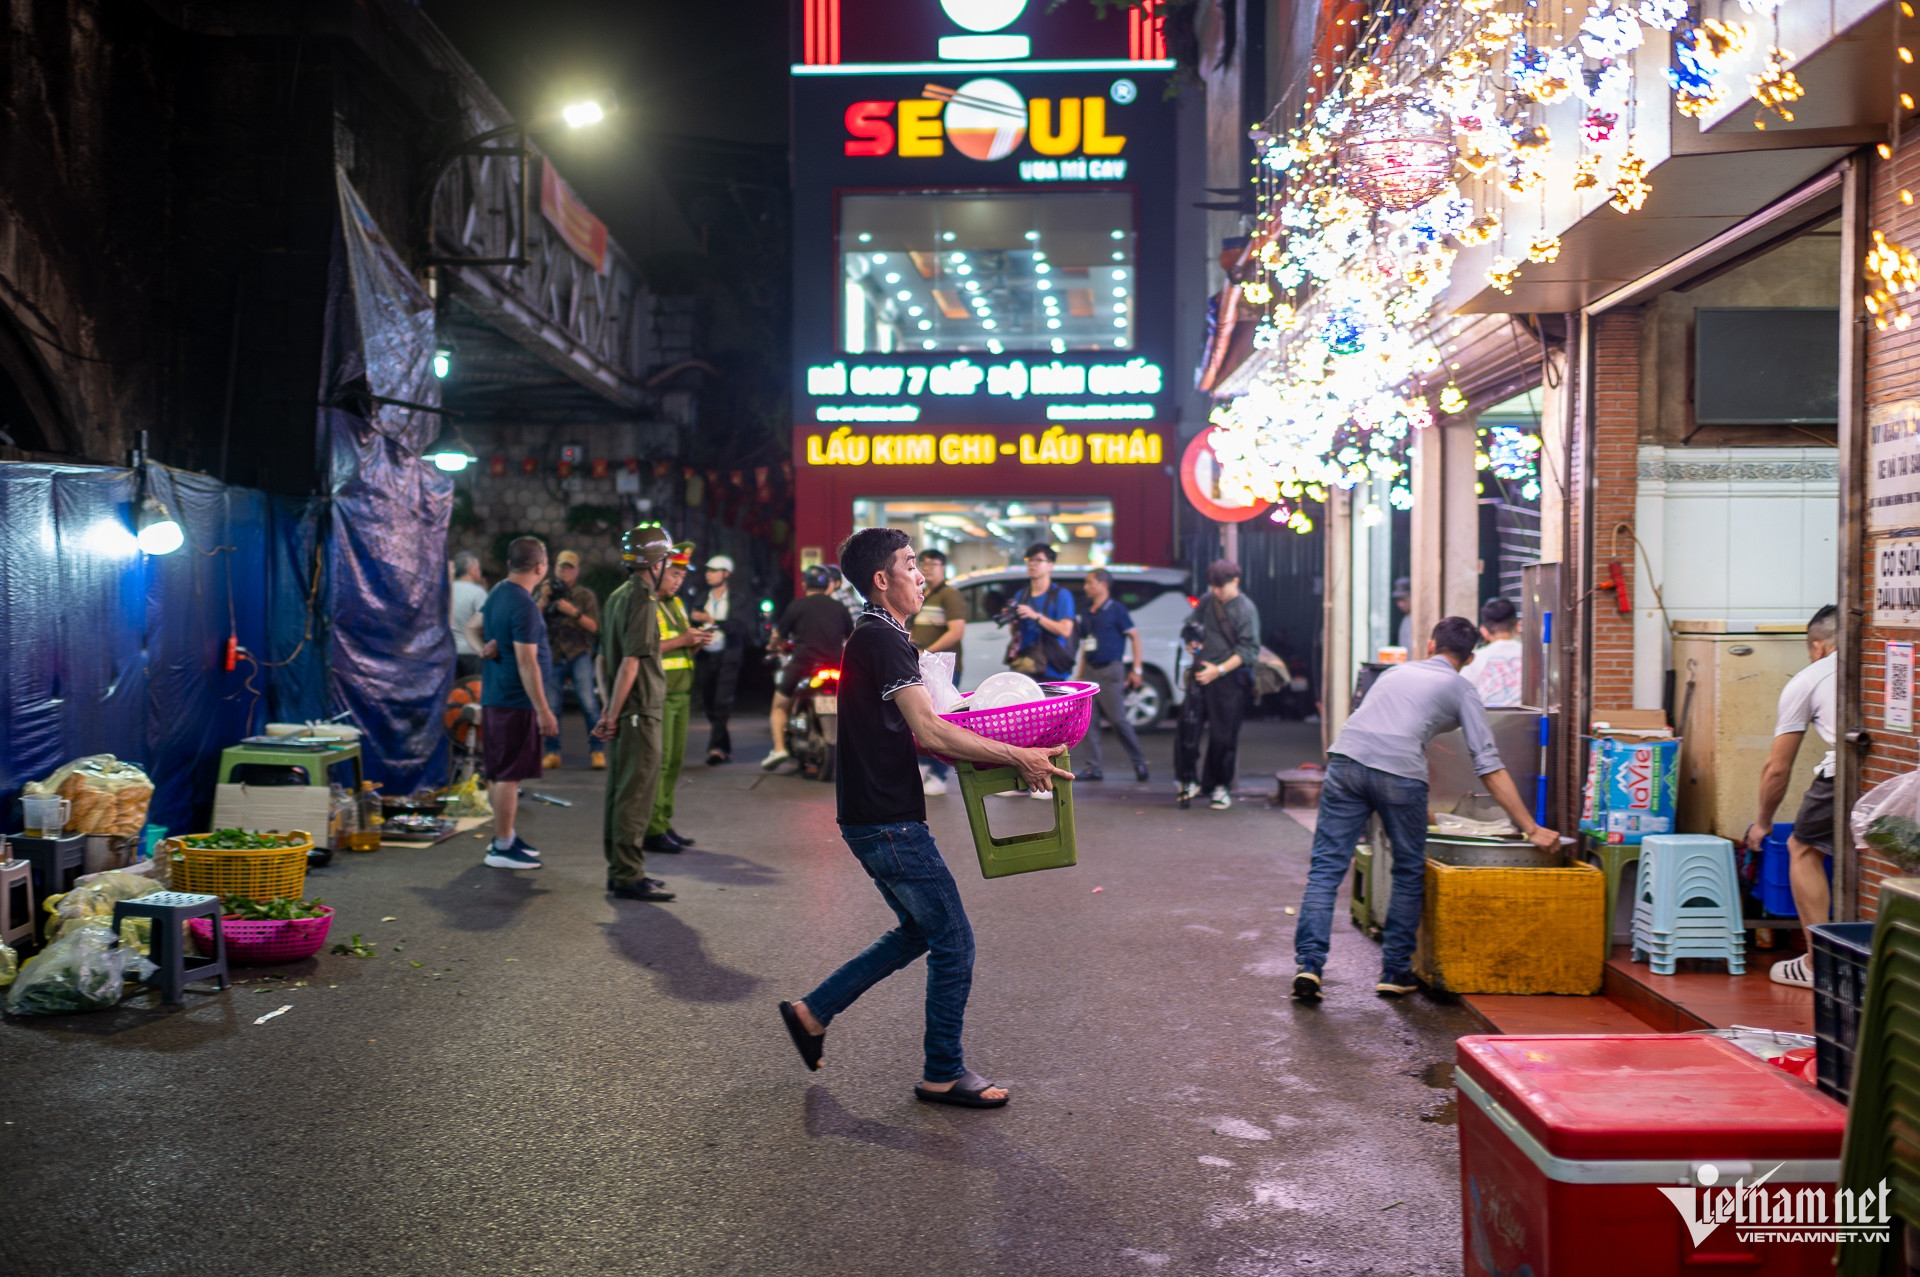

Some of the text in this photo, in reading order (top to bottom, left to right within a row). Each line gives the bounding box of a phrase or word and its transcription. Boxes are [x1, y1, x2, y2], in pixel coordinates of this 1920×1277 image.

[906, 366, 928, 396] 7
[872, 434, 937, 465] KIM
[939, 433, 996, 465] CHI
[1086, 427, 1162, 464] THÁI
